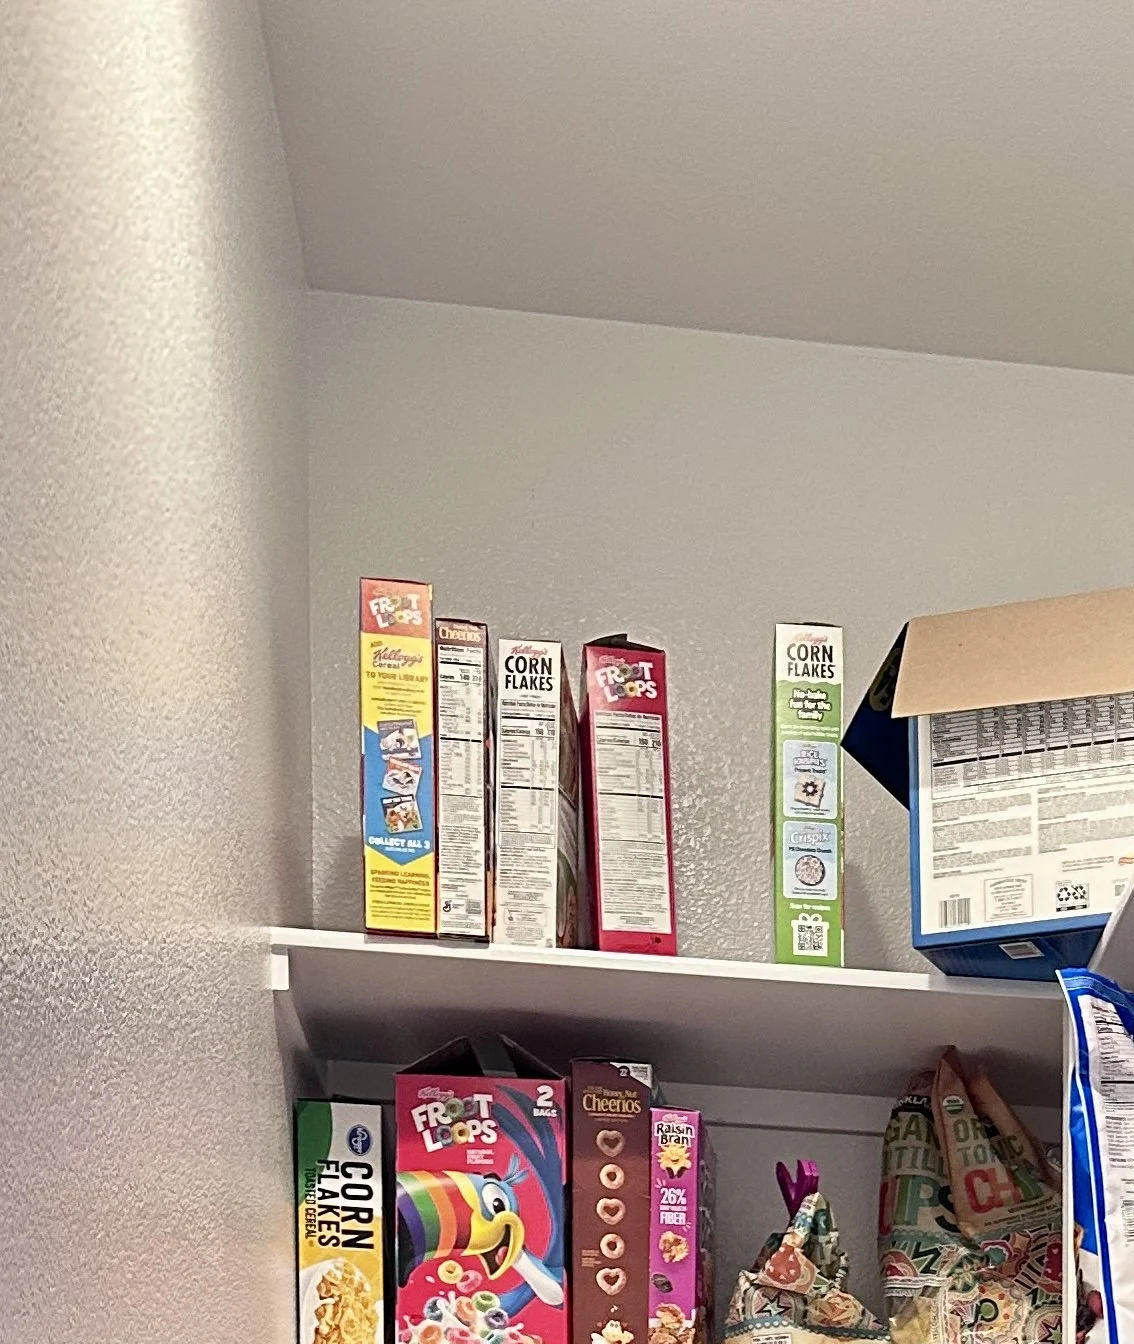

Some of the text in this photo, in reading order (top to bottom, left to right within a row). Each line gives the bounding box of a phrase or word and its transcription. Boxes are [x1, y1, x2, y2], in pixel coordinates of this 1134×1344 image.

[369, 594, 419, 615] FROOT
[376, 609, 422, 628] LOOPS
[373, 647, 423, 667] Kellogg's
[787, 643, 833, 662] CORN
[504, 656, 552, 675] CORN
[595, 662, 653, 687] FROOT
[788, 662, 836, 679] FLAKES
[505, 675, 554, 691] FLAKES
[603, 680, 658, 703] LOOPS
[369, 836, 405, 847] COLLECT
[424, 841, 430, 849] 3
[790, 831, 829, 845] Crispix
[536, 1085, 554, 1107] 2
[582, 1094, 641, 1112] Cheerios
[411, 1094, 493, 1132] FROOT
[533, 1108, 557, 1117] BAGS
[421, 1120, 498, 1152] LOOPS
[657, 1123, 693, 1135] Raisin
[660, 1134, 689, 1145] Bran
[304, 1168, 316, 1239] TOASTED CEREAL
[317, 1160, 340, 1247] FLAKES
[341, 1162, 374, 1249] CORN
[660, 1188, 687, 1205] 26%
